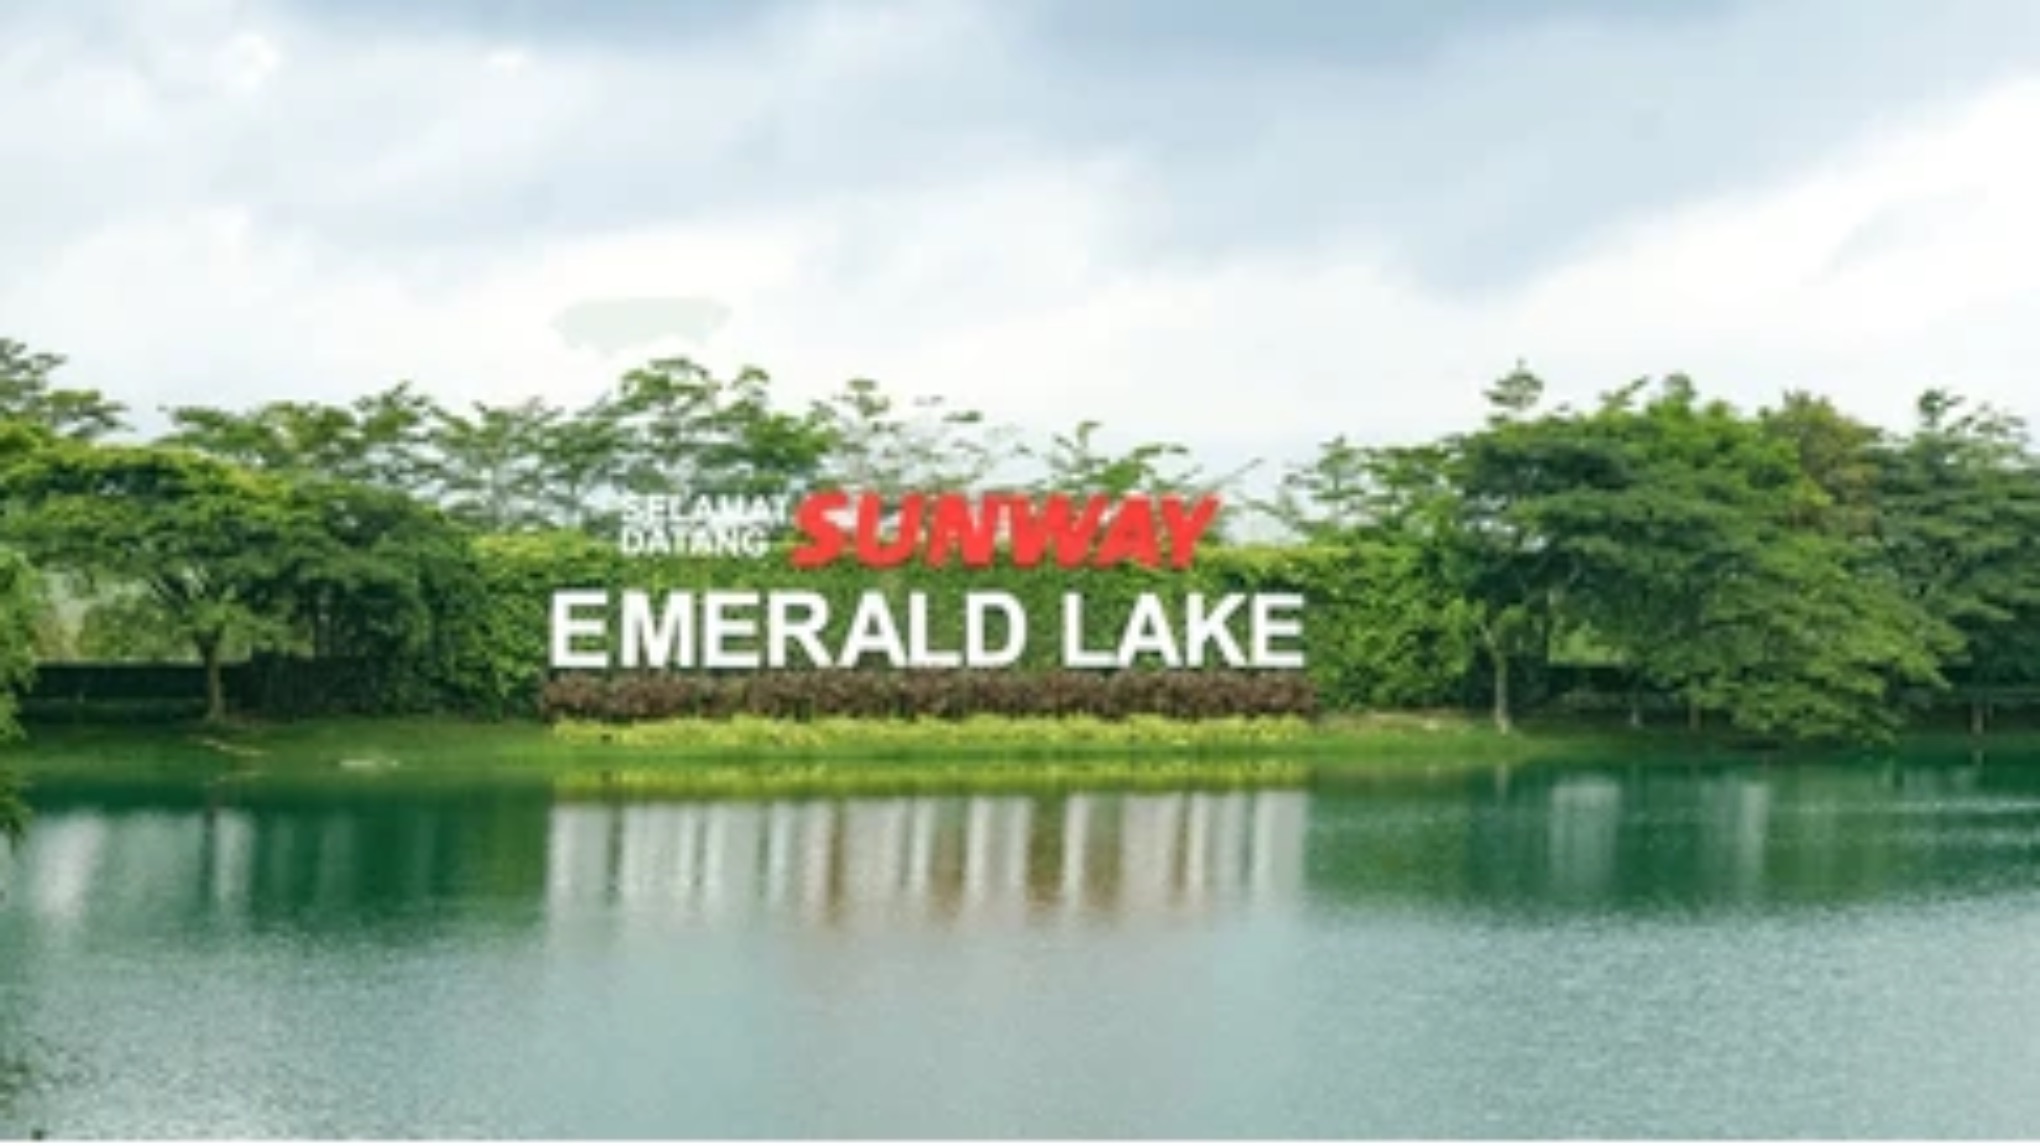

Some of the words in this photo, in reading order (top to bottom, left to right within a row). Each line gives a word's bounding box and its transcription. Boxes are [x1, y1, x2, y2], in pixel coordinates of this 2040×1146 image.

[620, 494, 790, 523] SELAMAT
[792, 491, 1221, 570] SUNWAY
[620, 525, 770, 557] DATANG
[550, 591, 1028, 669] EMERALD
[1063, 591, 1305, 669] LAKE
